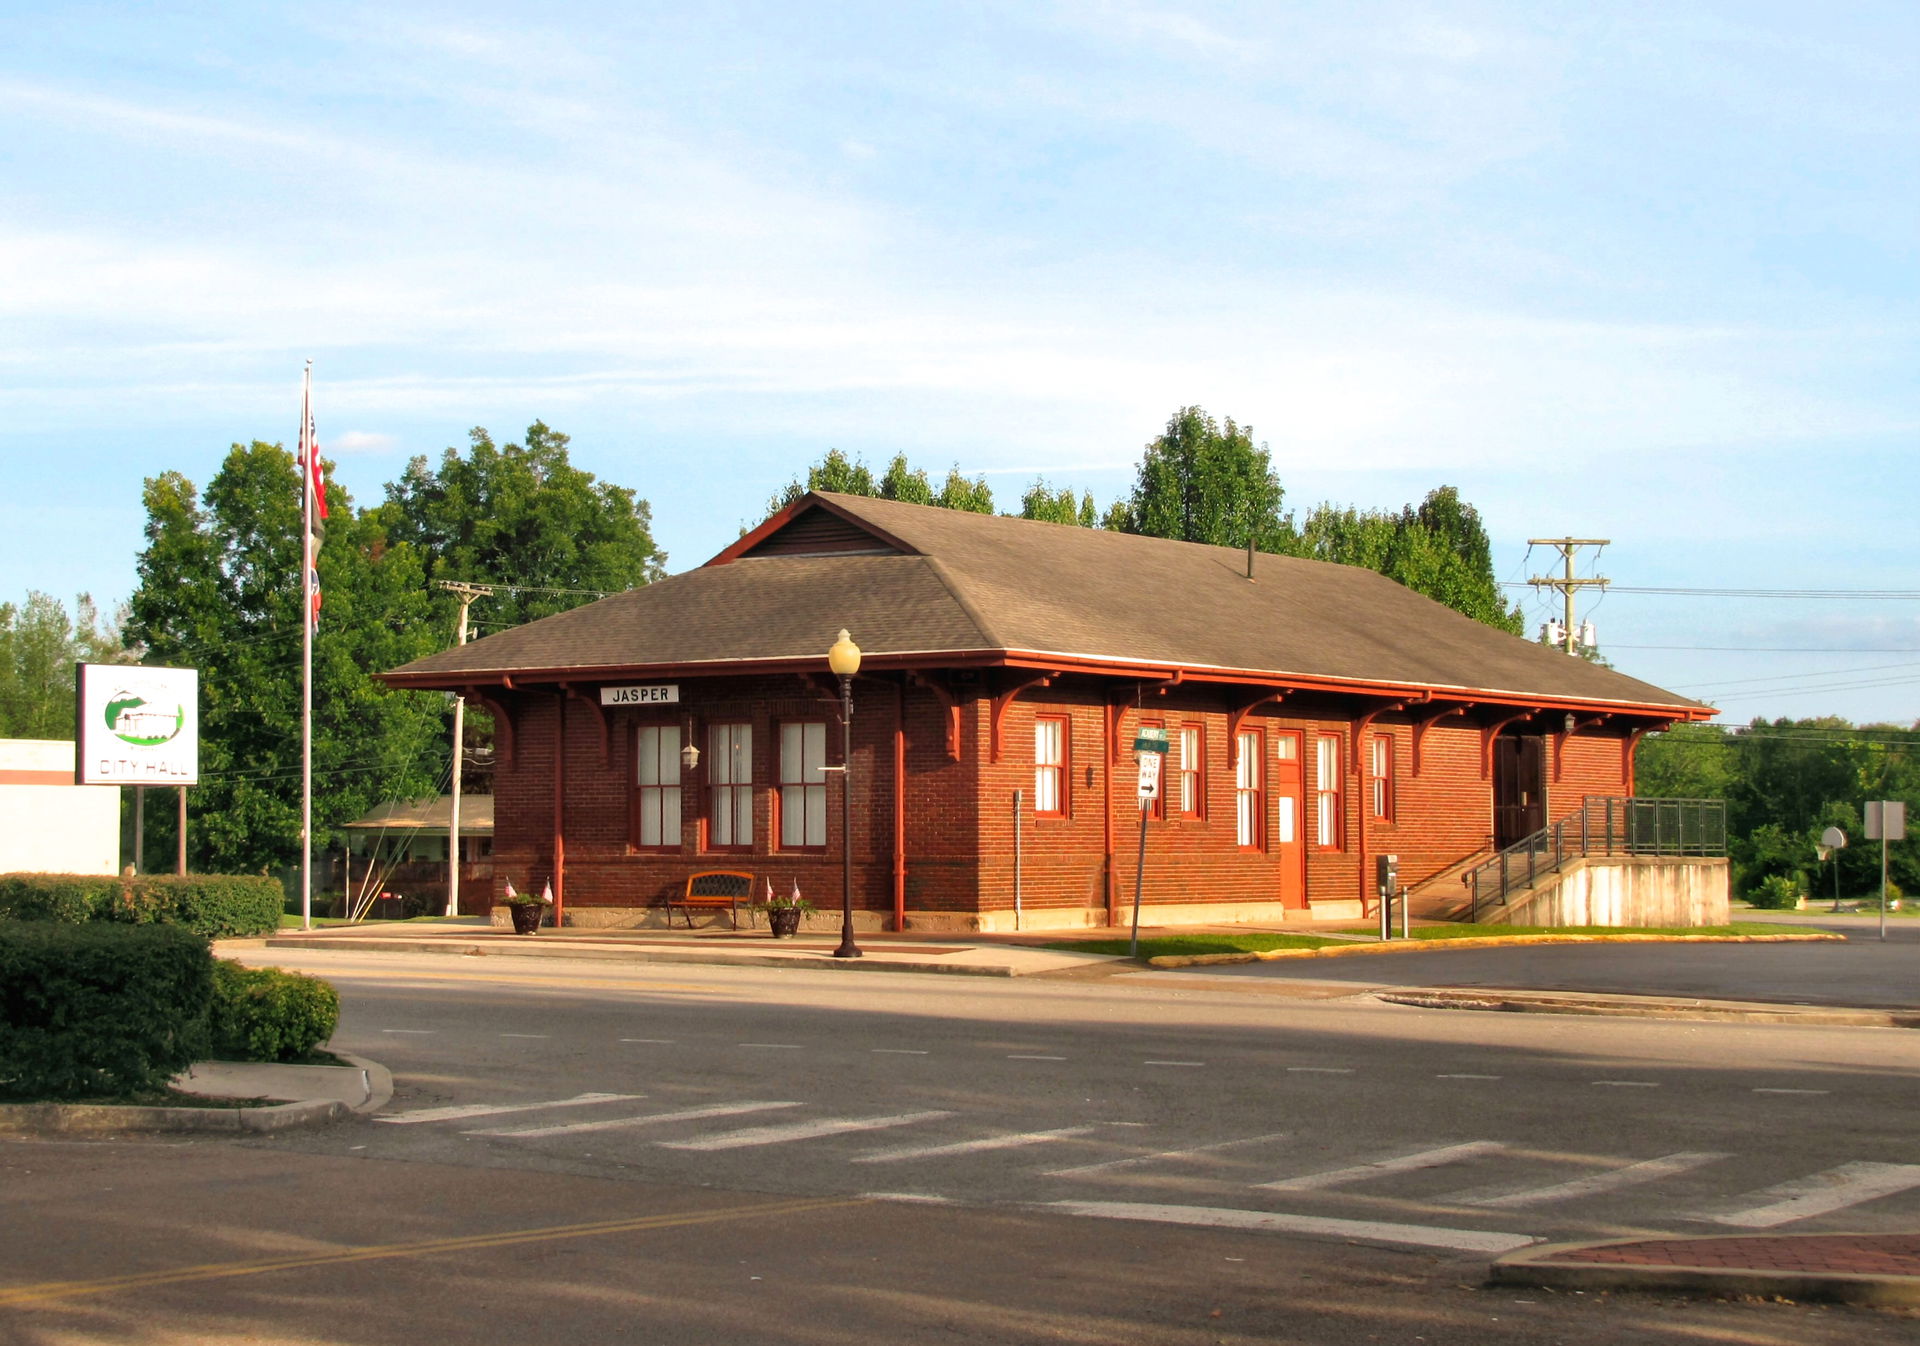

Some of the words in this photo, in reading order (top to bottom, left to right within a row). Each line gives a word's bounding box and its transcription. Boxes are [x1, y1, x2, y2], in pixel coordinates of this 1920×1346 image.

[612, 688, 668, 702] JASPER
[100, 760, 138, 775] CITY
[146, 761, 188, 776] HALL
[1142, 757, 1157, 769] ONE
[1142, 771, 1156, 779] WAY
